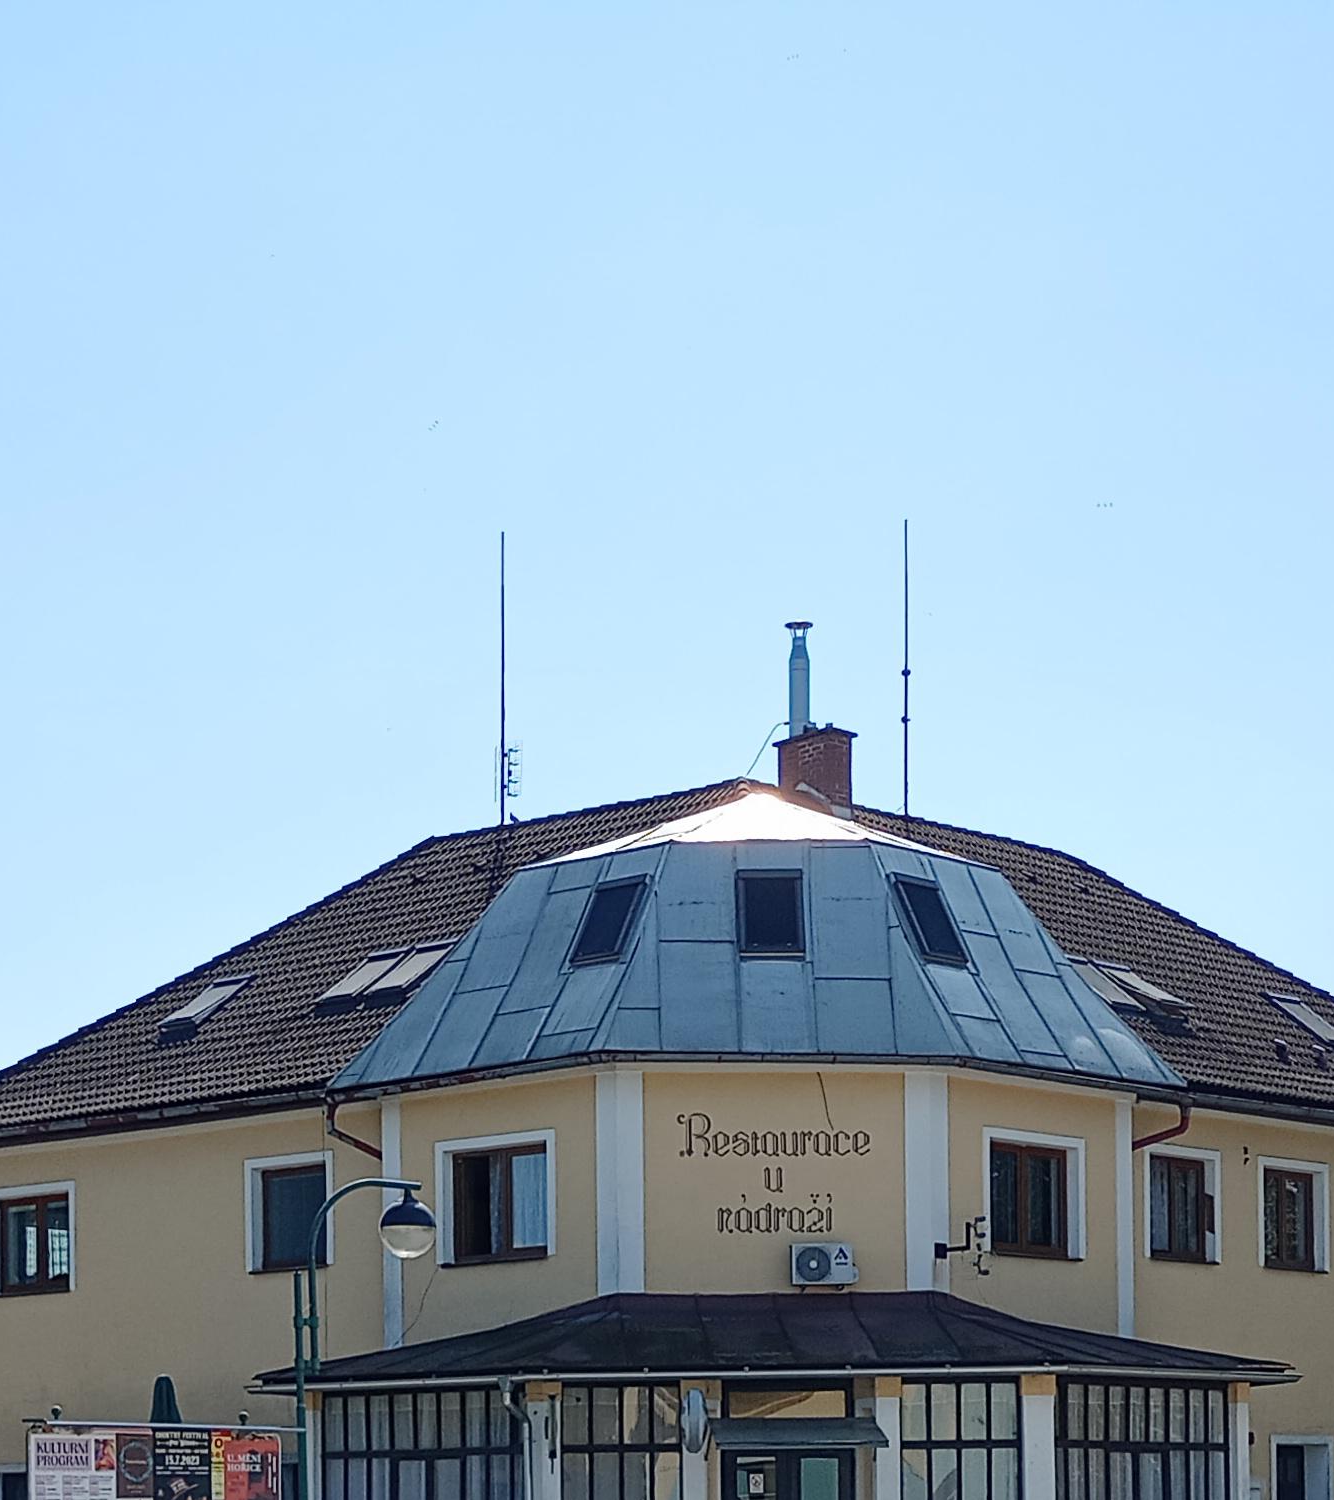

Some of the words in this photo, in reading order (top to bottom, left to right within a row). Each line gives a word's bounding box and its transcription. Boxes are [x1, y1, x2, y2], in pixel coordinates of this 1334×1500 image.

[676, 1112, 871, 1157] Restaurace
[717, 1193, 833, 1234] nádraží
[36, 1440, 89, 1454] KULTURNÍ
[36, 1455, 89, 1467] PROGRAM
